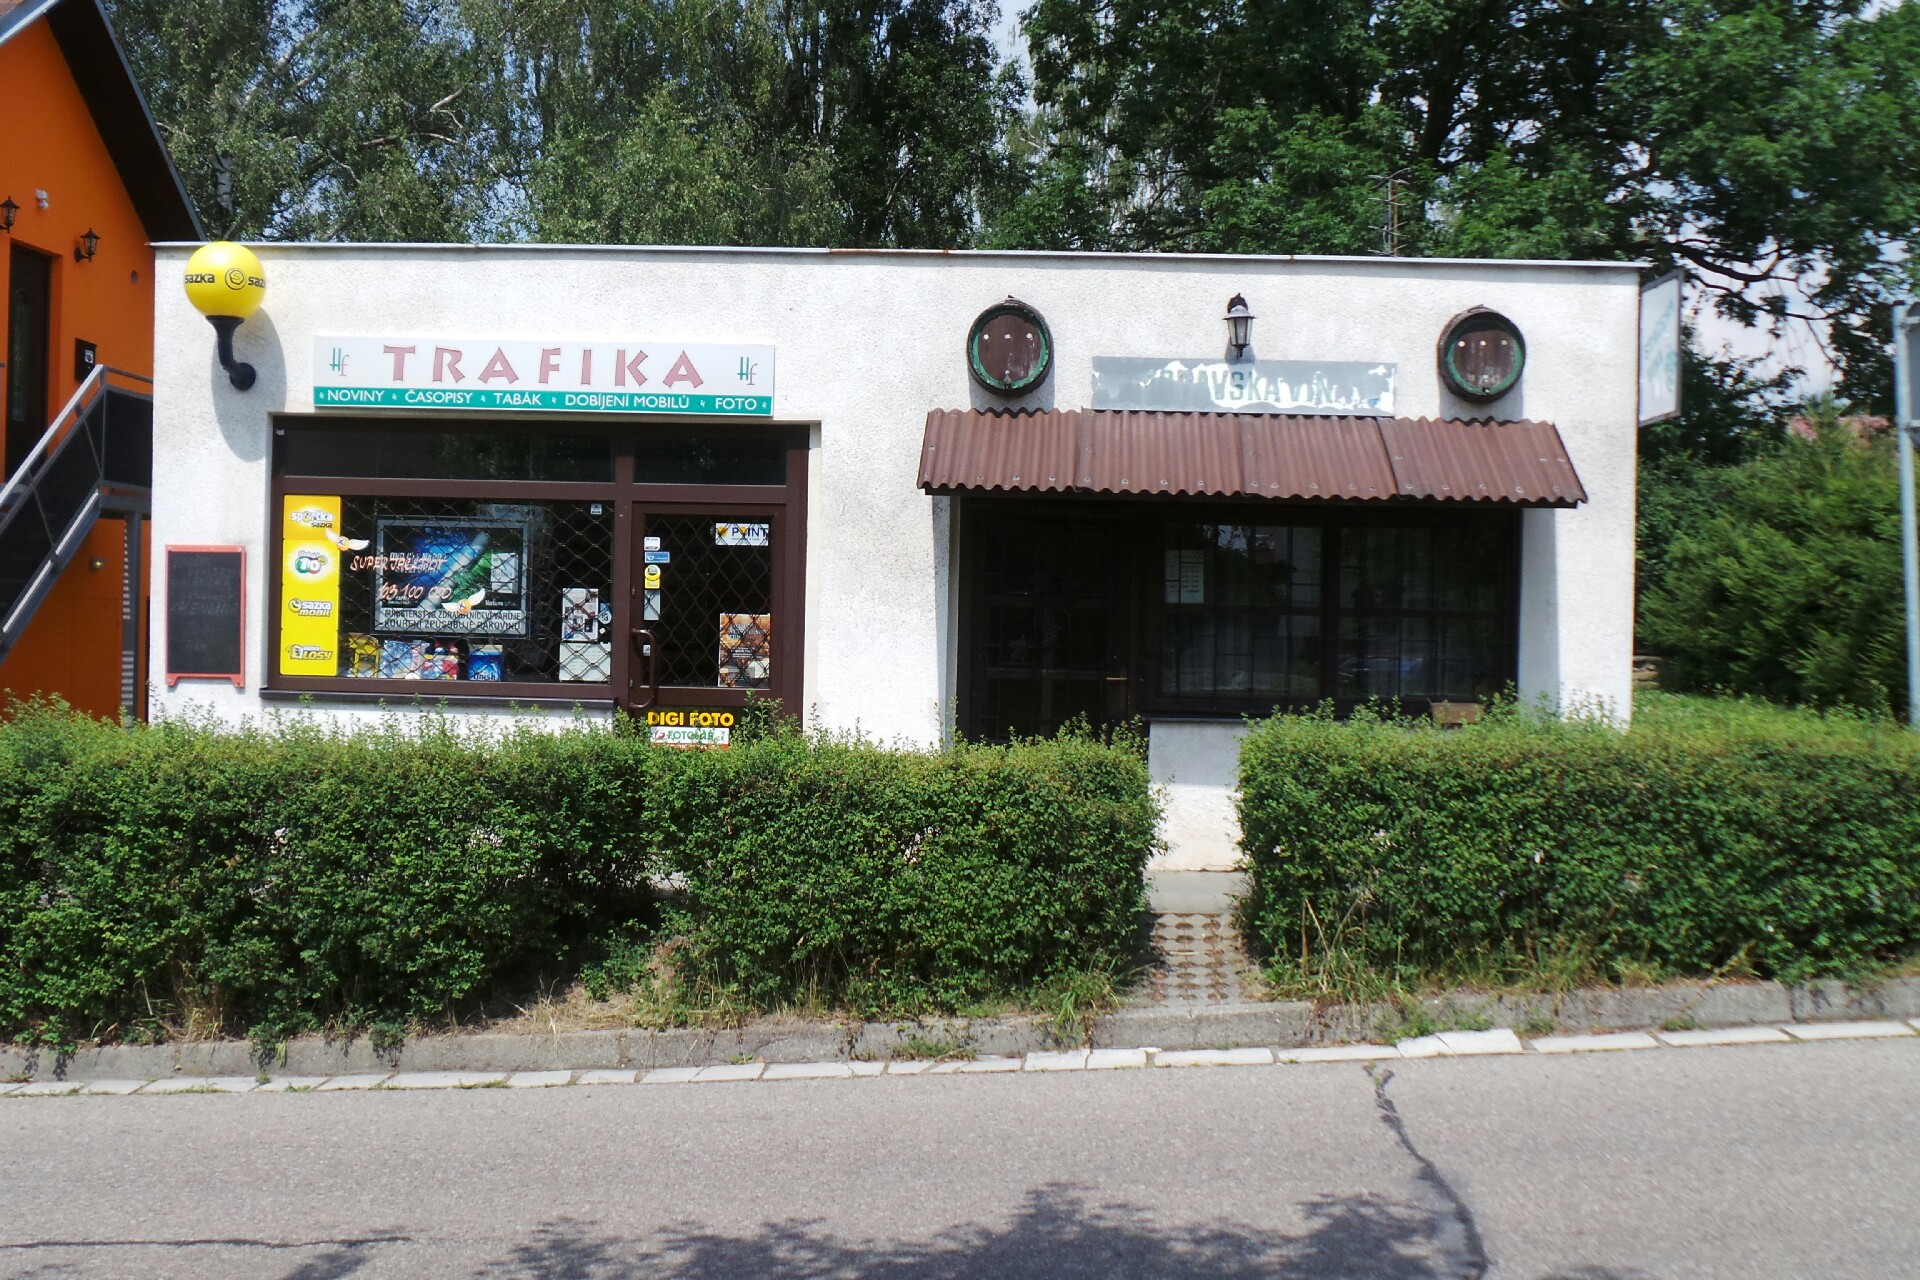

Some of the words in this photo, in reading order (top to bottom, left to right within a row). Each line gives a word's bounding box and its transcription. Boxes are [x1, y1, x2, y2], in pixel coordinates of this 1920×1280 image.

[383, 345, 704, 388] TRAFIKA
[327, 389, 385, 402] NOVINY
[405, 388, 474, 404] ČASOPISY
[493, 391, 542, 406] TABÁK
[565, 393, 629, 410] DOBÍJENÍ
[633, 395, 690, 409] MOBILŮ
[715, 397, 757, 411] FOTO
[349, 555, 388, 571] SUPER
[303, 651, 333, 660] LOSY
[648, 711, 684, 726] DIGI
[689, 712, 734, 727] FOTO
